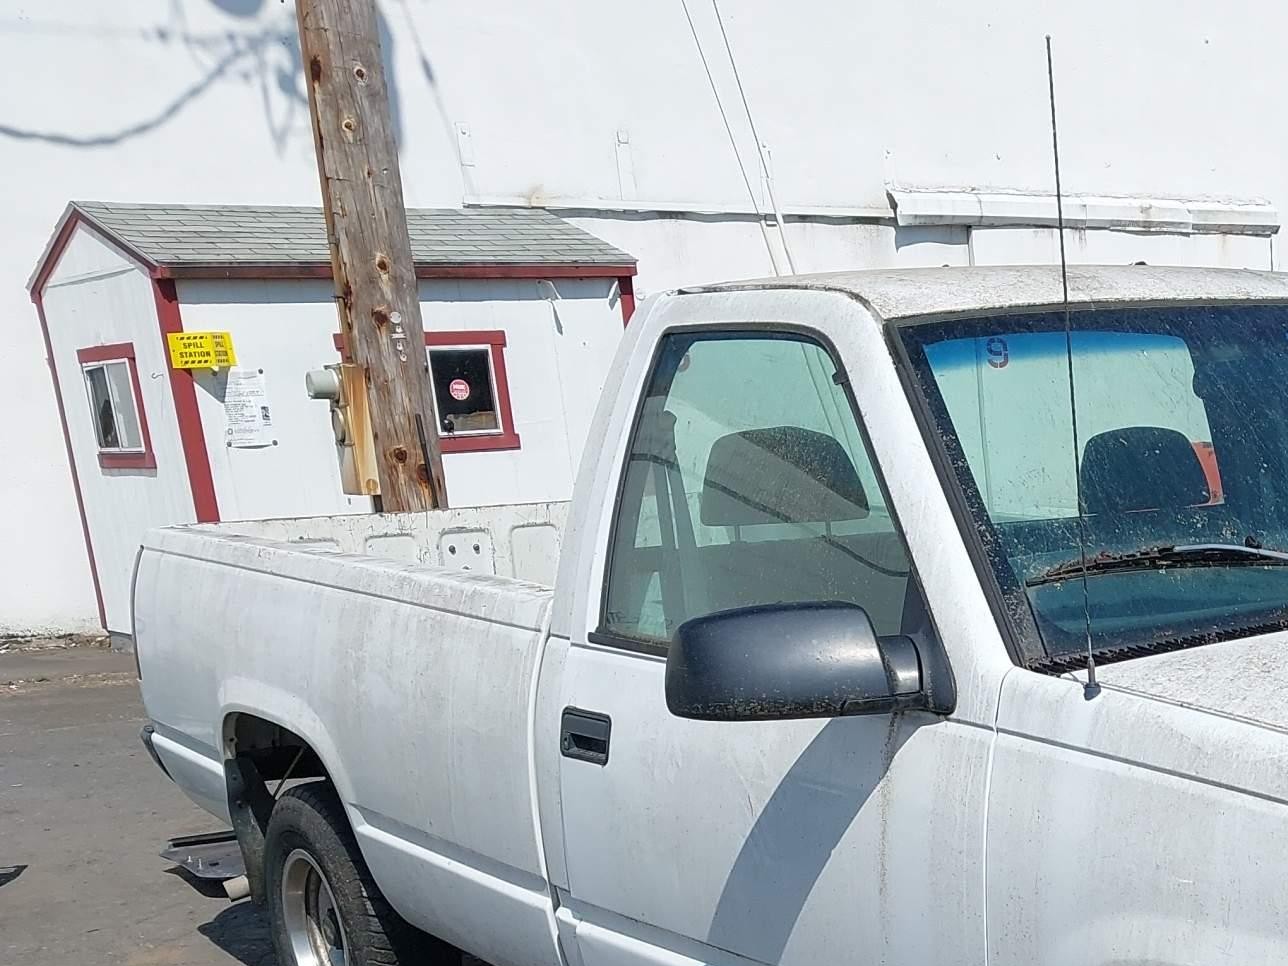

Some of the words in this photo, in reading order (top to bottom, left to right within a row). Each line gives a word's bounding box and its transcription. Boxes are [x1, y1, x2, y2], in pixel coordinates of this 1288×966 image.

[182, 341, 205, 350] SPILL
[179, 350, 212, 359] STATION
[987, 337, 1009, 369] 9
